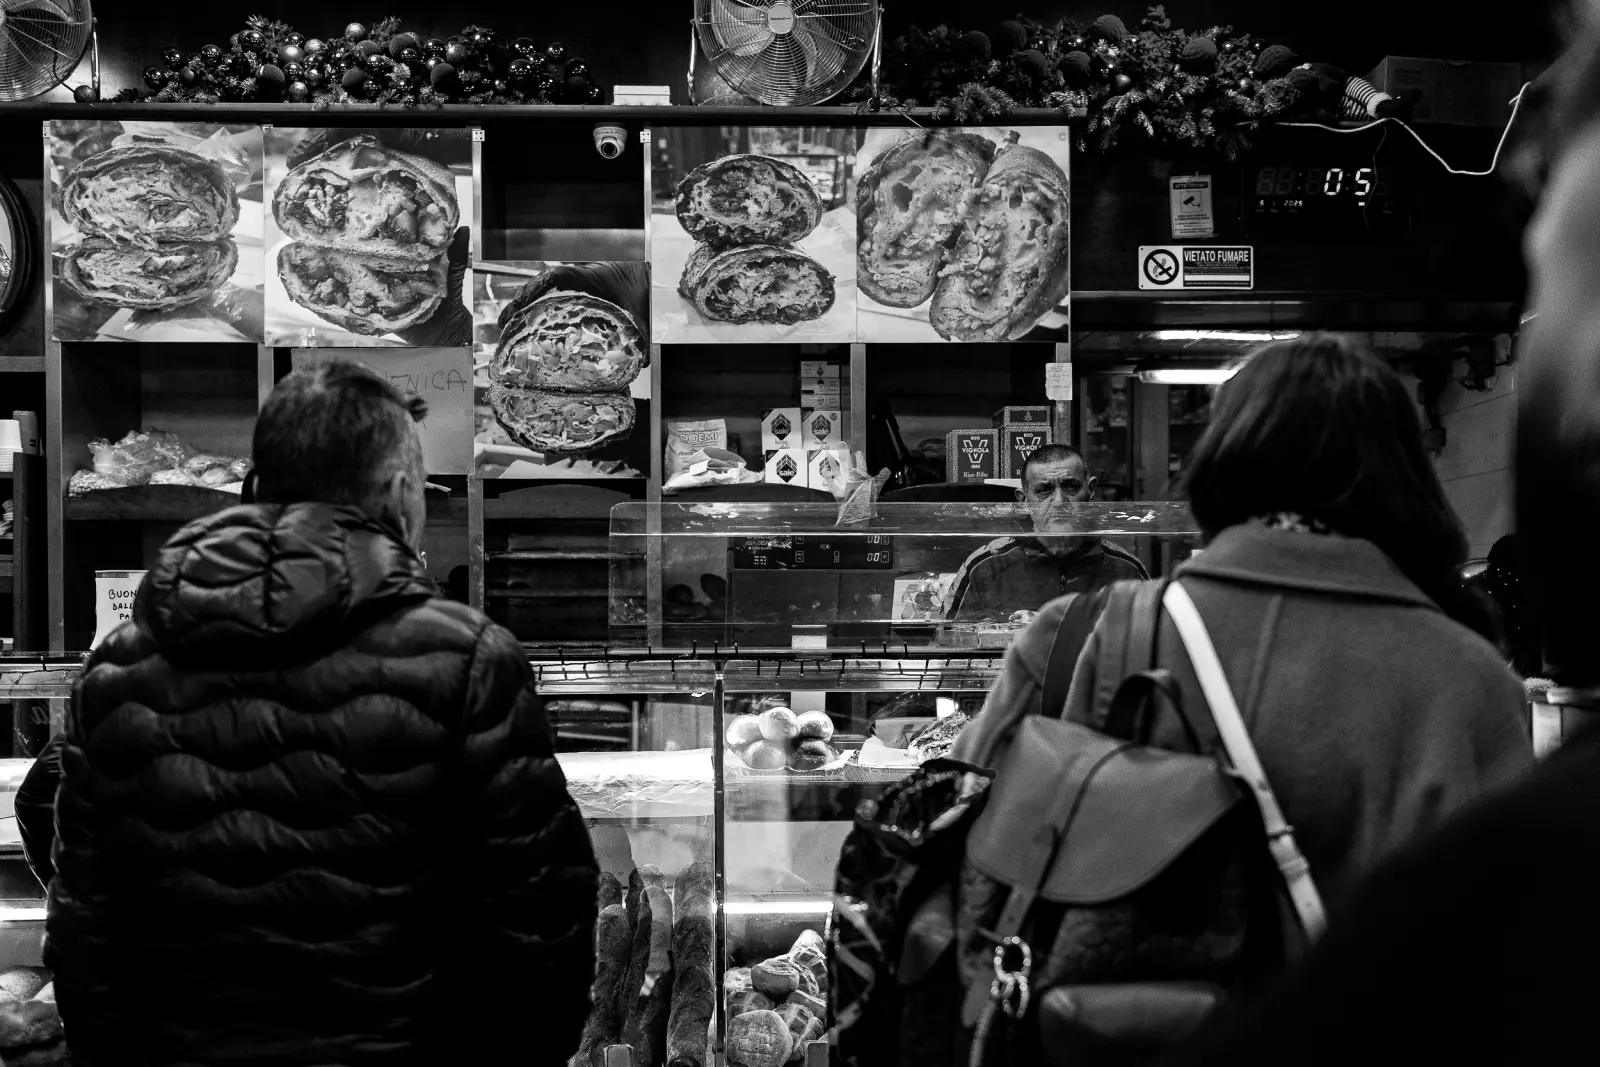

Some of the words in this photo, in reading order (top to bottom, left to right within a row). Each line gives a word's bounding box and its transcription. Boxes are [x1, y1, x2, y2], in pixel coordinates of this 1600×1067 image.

[1284, 199, 1303, 207] 2025
[1184, 250, 1216, 262] VIETATO
[1217, 250, 1249, 262] FUMARE
[779, 469, 795, 477] sale
[867, 552, 880, 562] 00
